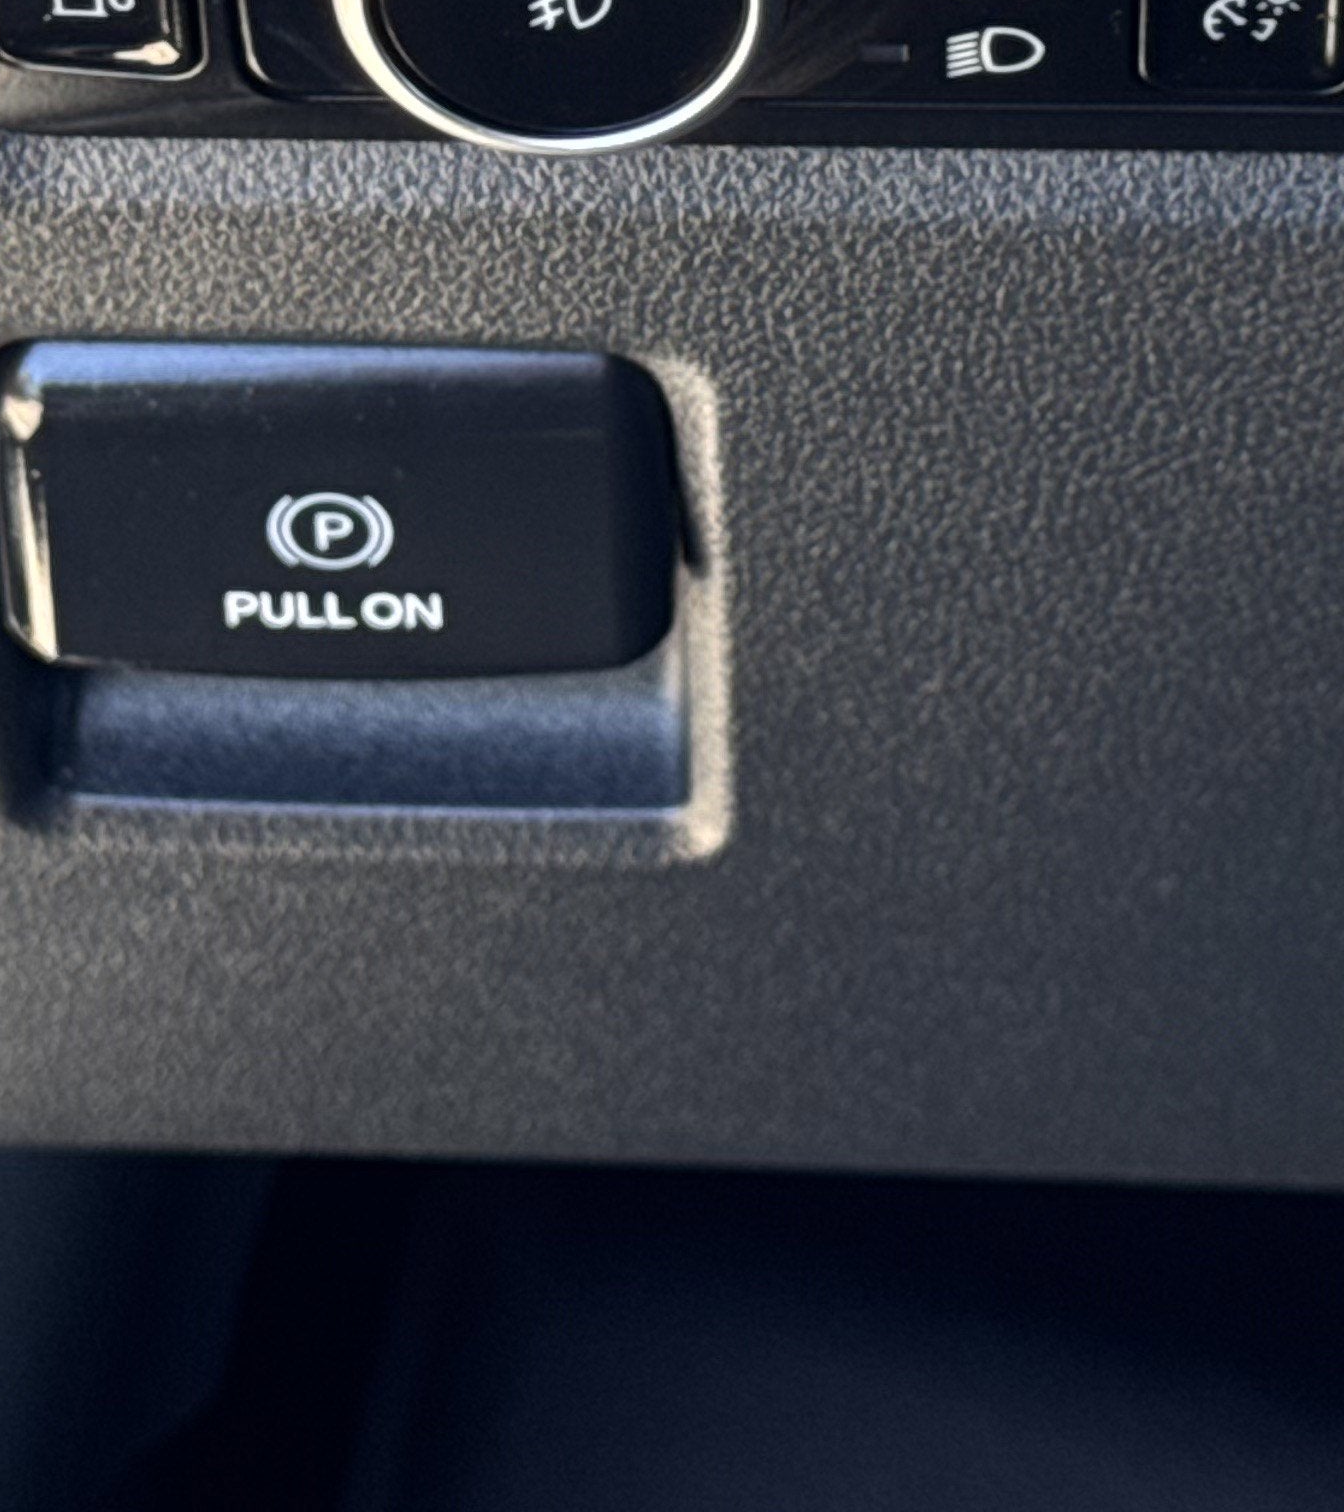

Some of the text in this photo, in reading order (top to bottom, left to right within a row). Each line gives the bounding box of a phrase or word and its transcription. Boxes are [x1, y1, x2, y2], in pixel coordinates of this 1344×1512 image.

[313, 510, 355, 552] P
[222, 590, 444, 631] PULL ON
